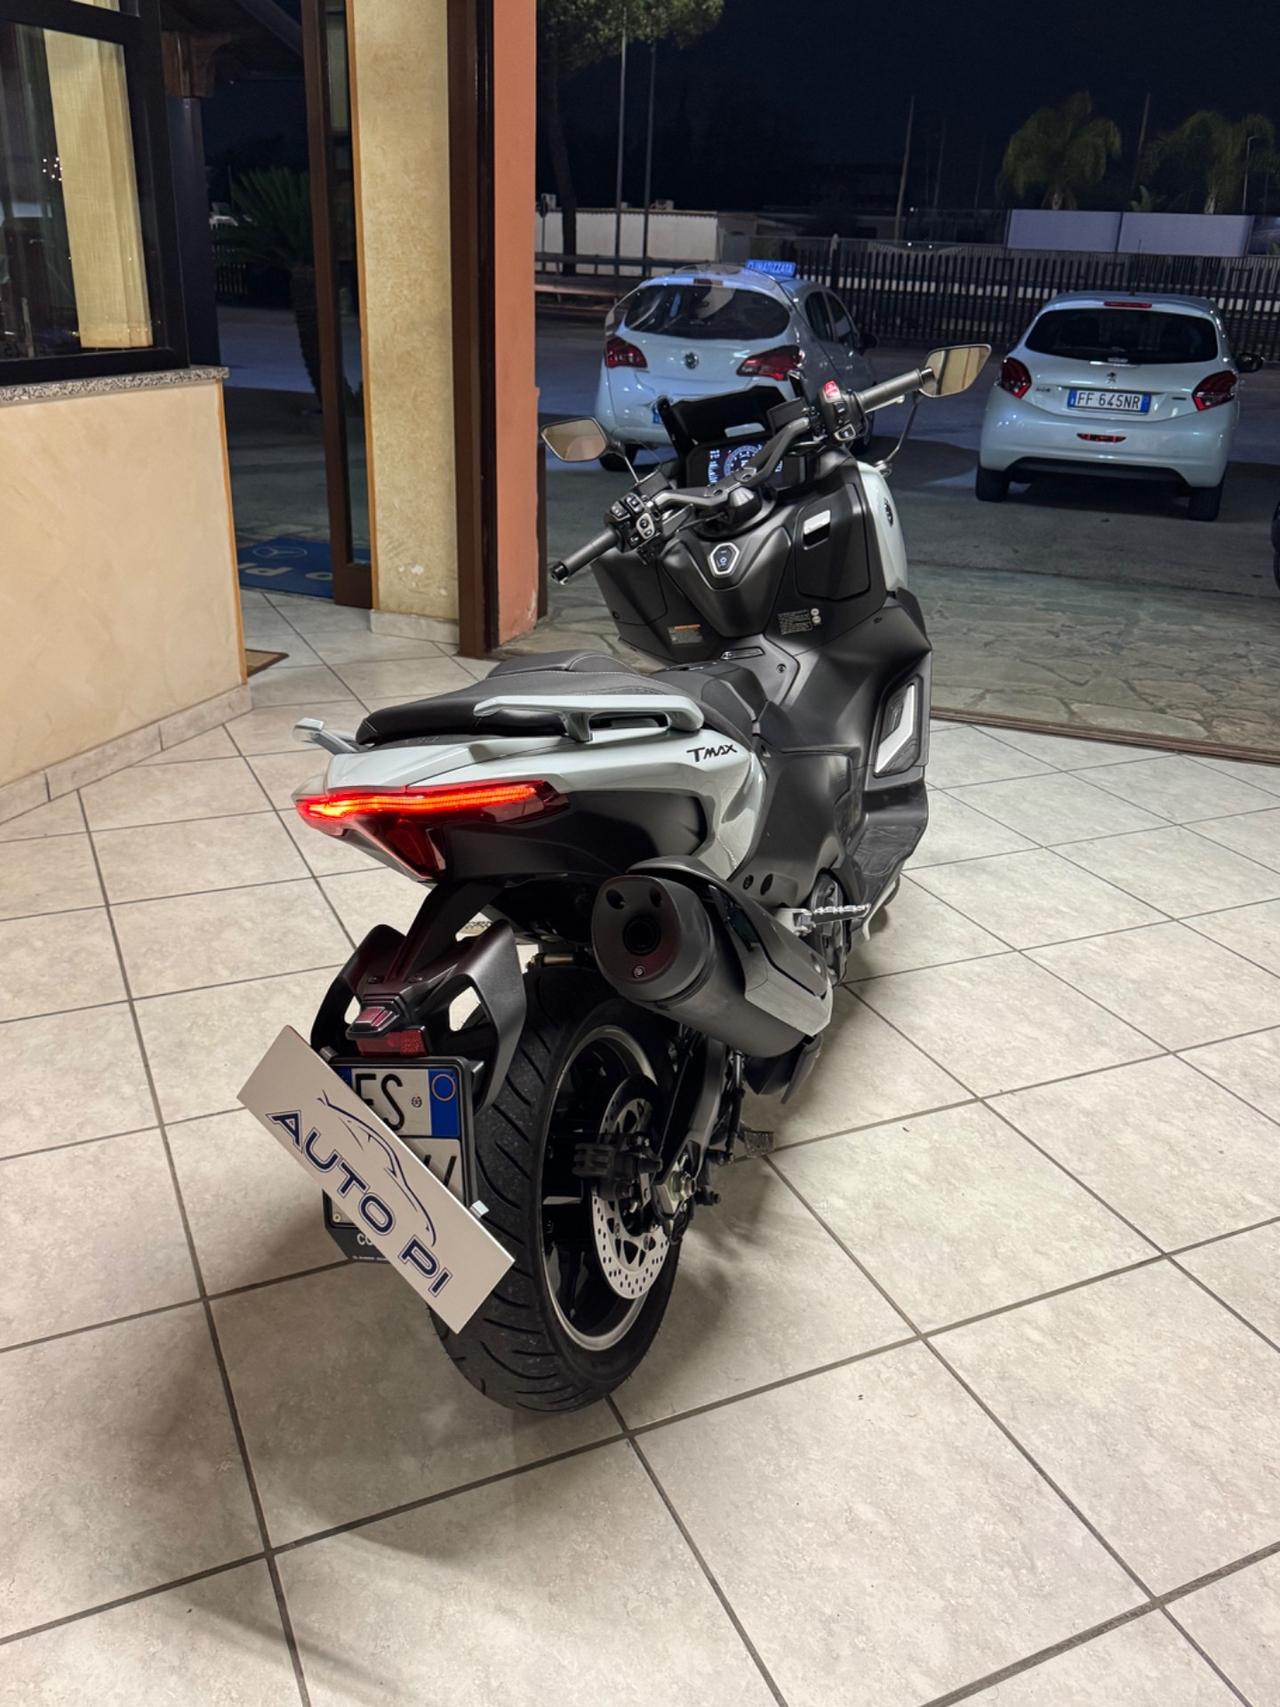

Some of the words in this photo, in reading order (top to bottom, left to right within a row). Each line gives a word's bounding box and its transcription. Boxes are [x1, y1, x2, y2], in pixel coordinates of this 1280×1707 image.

[1077, 391, 1094, 405] FF
[1099, 391, 1141, 410] 645NR
[686, 744, 738, 762] TMAX
[264, 1109, 396, 1236] AUTO
[398, 1234, 453, 1298] PI
